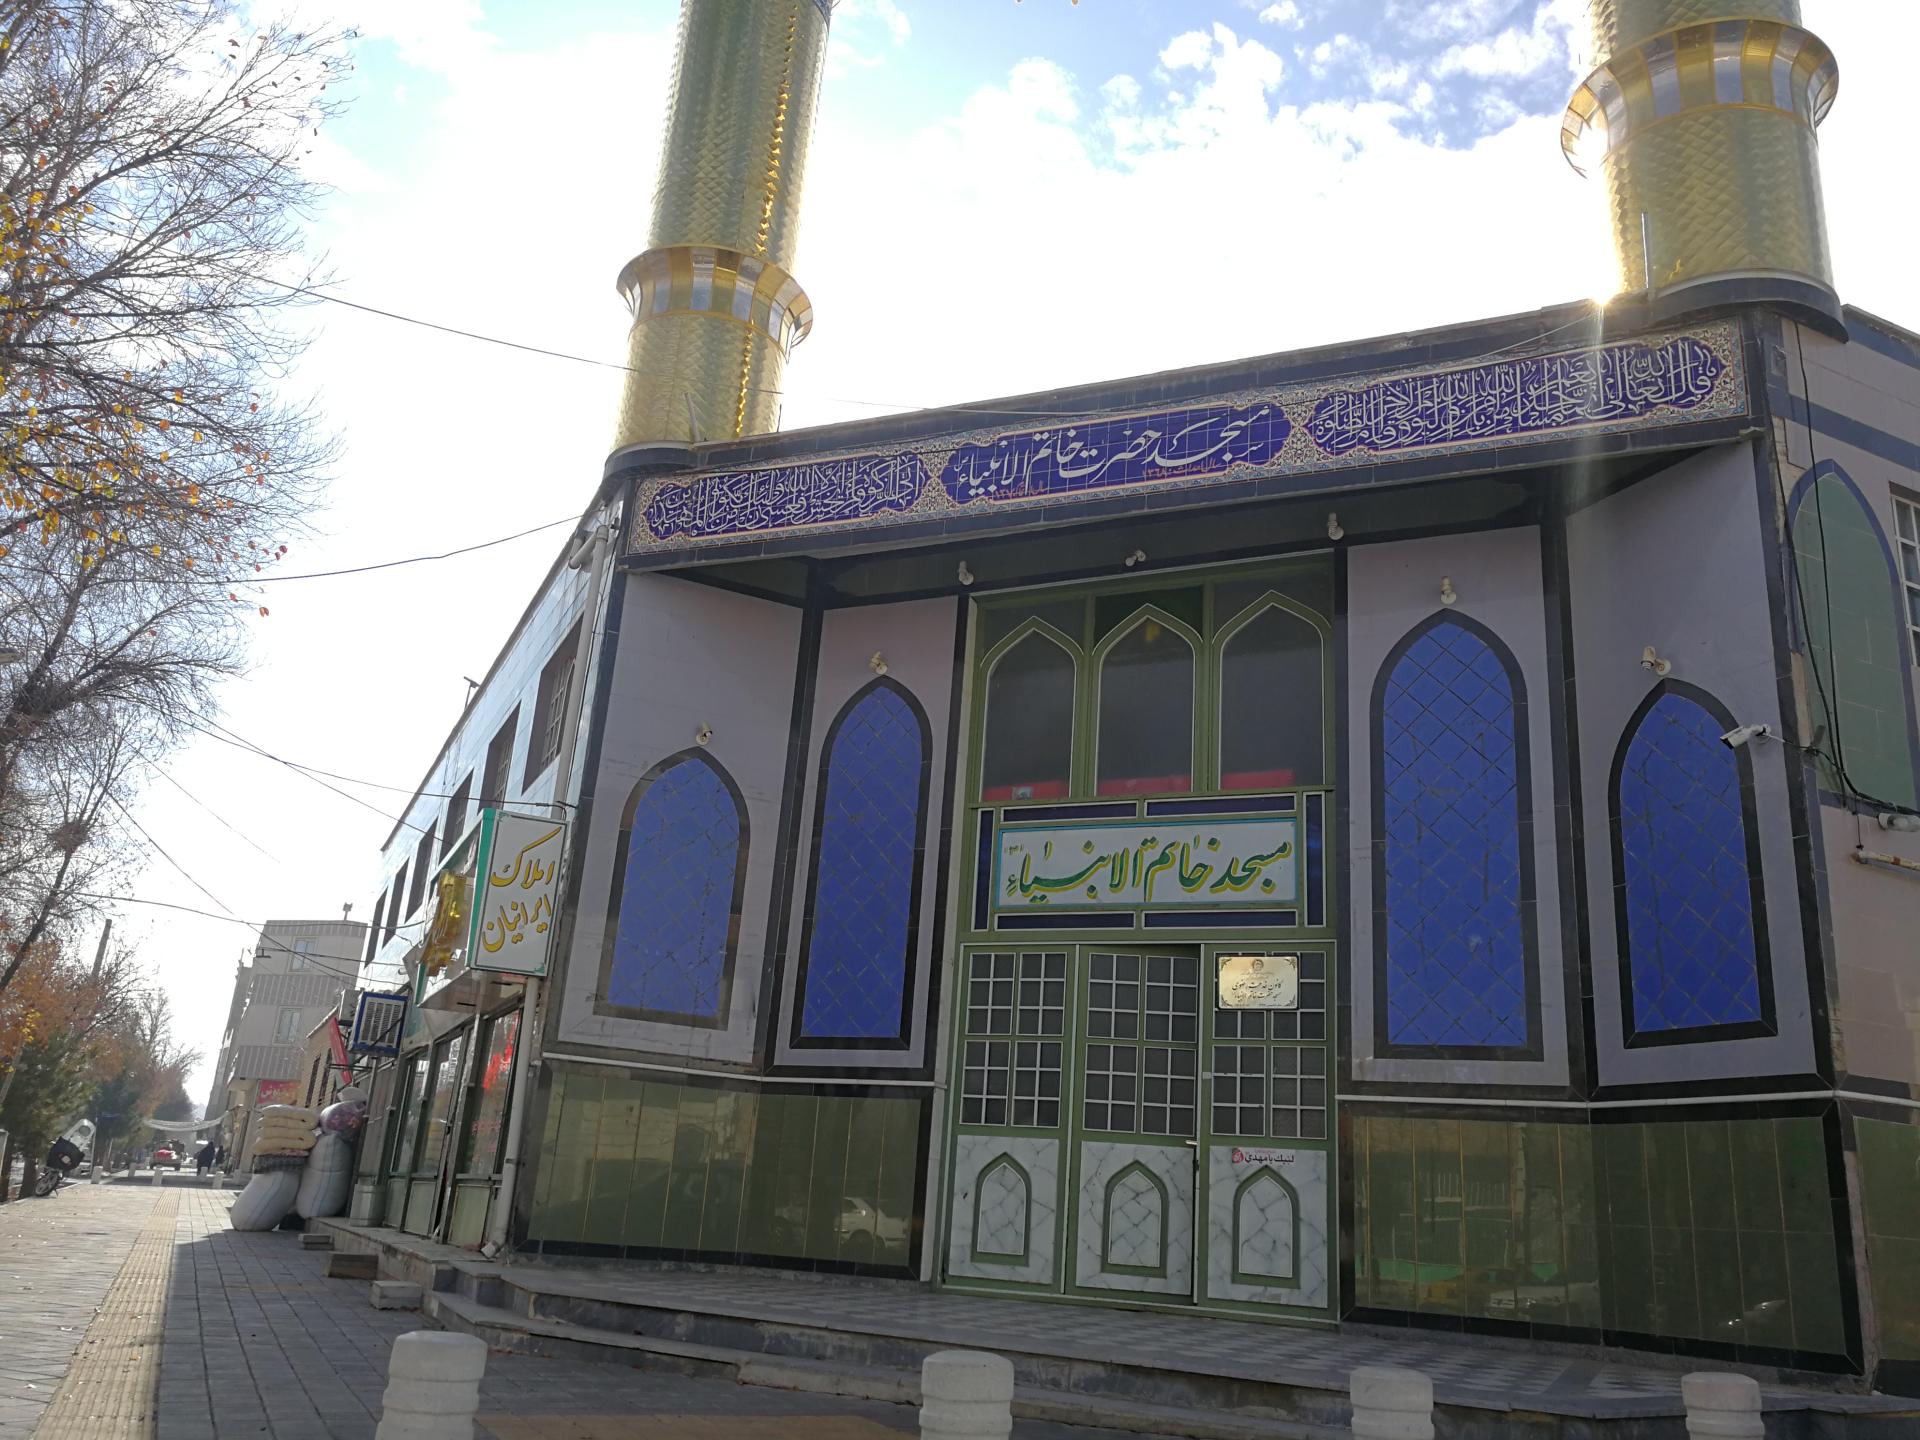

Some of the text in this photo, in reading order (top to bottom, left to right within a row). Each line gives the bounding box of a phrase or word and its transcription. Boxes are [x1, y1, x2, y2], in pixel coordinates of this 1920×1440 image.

[1026, 428, 1084, 494] خاتم
[1059, 428, 1162, 483] حضرت
[1141, 404, 1270, 468] مسجد
[490, 826, 562, 889] املاک
[1144, 834, 1221, 902] خاتم
[1209, 838, 1293, 895] مسجد
[482, 893, 552, 953] ایرانیان
